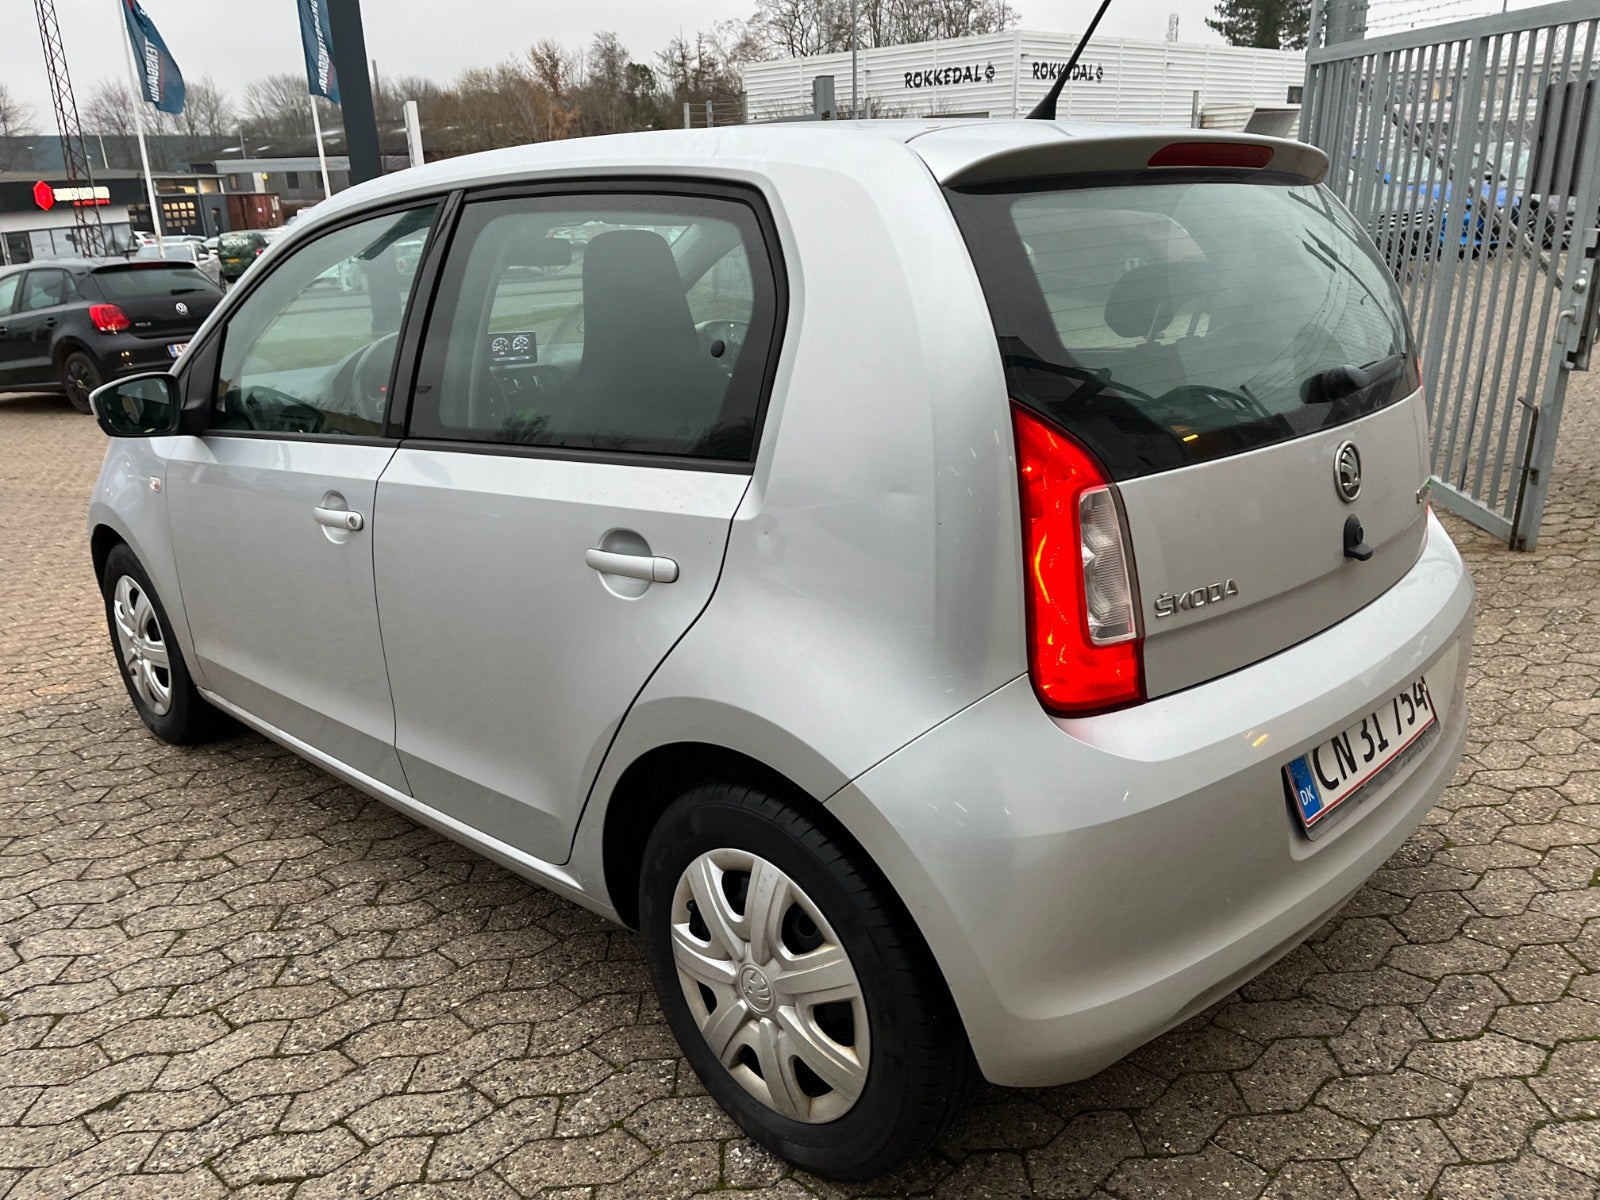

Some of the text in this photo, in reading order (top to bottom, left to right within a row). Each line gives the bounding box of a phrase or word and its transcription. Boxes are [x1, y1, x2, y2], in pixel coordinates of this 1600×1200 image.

[904, 65, 982, 89] ROKKEDAL
[1032, 61, 1094, 81] ROKKDAL
[1155, 578, 1239, 618] ŠKODA
[1312, 731, 1358, 791] CN
[1360, 712, 1389, 763] 31
[1299, 789, 1315, 806] DK
